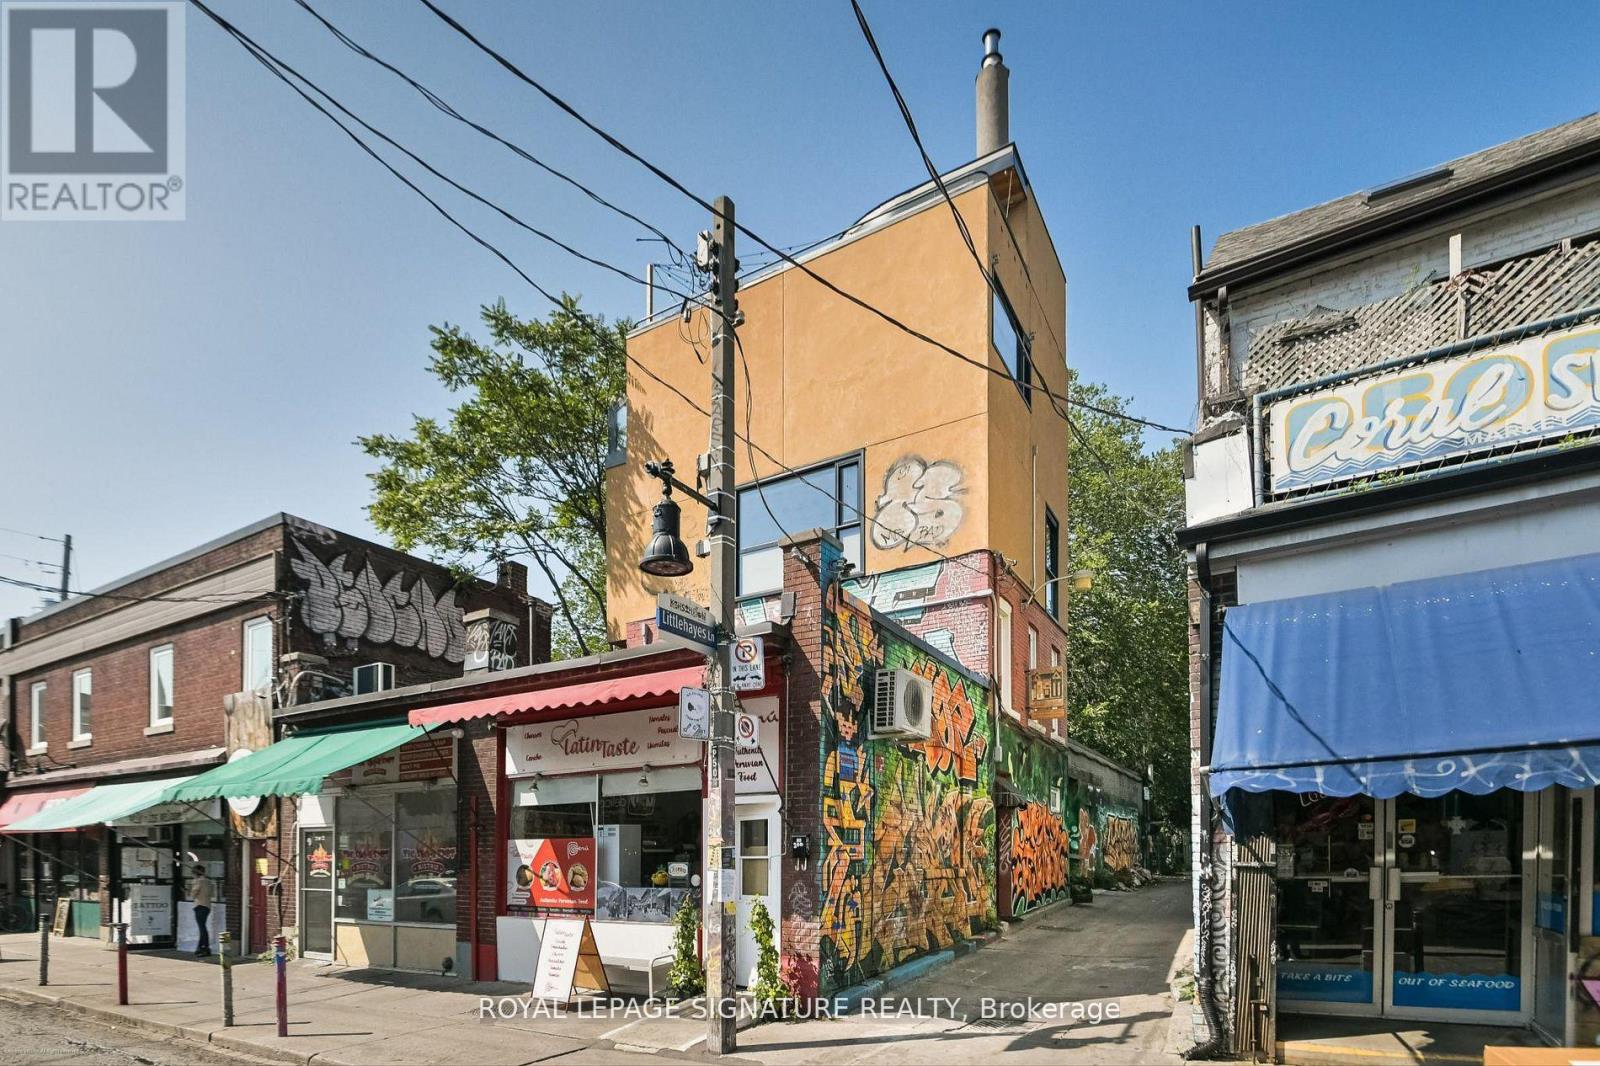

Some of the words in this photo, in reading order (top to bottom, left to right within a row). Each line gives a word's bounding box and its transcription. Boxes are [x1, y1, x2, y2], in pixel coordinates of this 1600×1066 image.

[1289, 361, 1514, 473] Coral
[662, 609, 707, 639] Littlehayes
[707, 629, 715, 642] Ln
[564, 738, 600, 756] Latin
[600, 737, 640, 759] Taste
[1280, 972, 1311, 982] TAKE
[1325, 974, 1353, 983] BITE
[1398, 977, 1425, 986] OUT
[1428, 978, 1446, 987] OF
[1449, 979, 1515, 990] SEAFOOD
